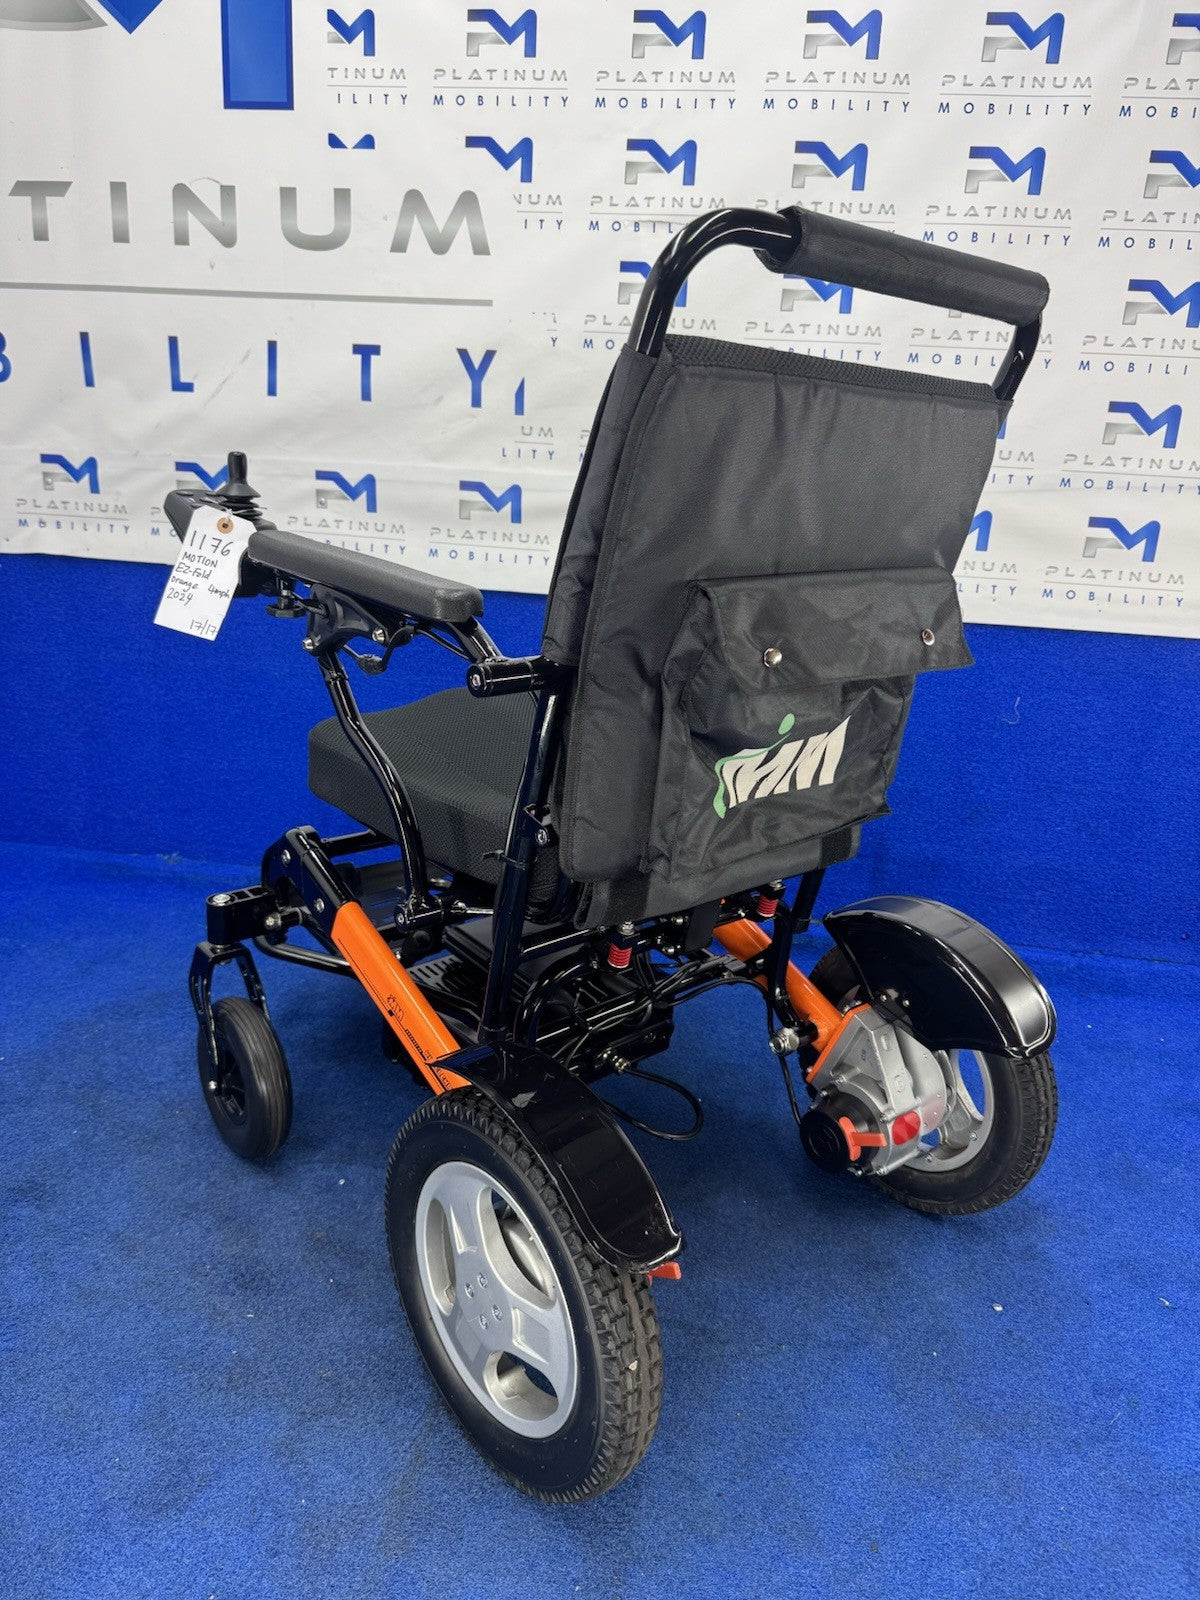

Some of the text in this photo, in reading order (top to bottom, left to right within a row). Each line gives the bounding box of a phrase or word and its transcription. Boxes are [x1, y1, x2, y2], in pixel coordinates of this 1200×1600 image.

[433, 69, 568, 82] PLATINUM
[596, 70, 736, 84] PLATINUM
[765, 71, 911, 86] PLATINUM
[941, 74, 1093, 89] PLATINUM
[1123, 77, 1200, 91] PLAT
[433, 95, 569, 108] MOBILITY
[594, 97, 737, 109] MOBILITY
[763, 98, 910, 113] MOBILITY
[938, 102, 1092, 116] MOBILITY
[1118, 105, 1198, 119] MOBI
[590, 195, 726, 209] PLATINUM
[8, 180, 491, 256] TINUM
[925, 205, 1072, 220] PLATINUM
[922, 231, 1071, 247] MOBILITY
[1097, 236, 1193, 251] MOBIL
[745, 321, 882, 337] PLATINUM
[16, 498, 129, 514] PLATINUM
[18, 518, 131, 534] MOBILITY
[287, 516, 406, 535] PLATINUM
[189, 530, 235, 557] 1176
[429, 526, 551, 546] PLATINUM
[182, 551, 219, 568] MOTION
[428, 548, 550, 566] MOBILITY
[1044, 565, 1185, 585] PLATINUM
[166, 587, 194, 607] 2024
[1041, 588, 1184, 607] MOBILITY
